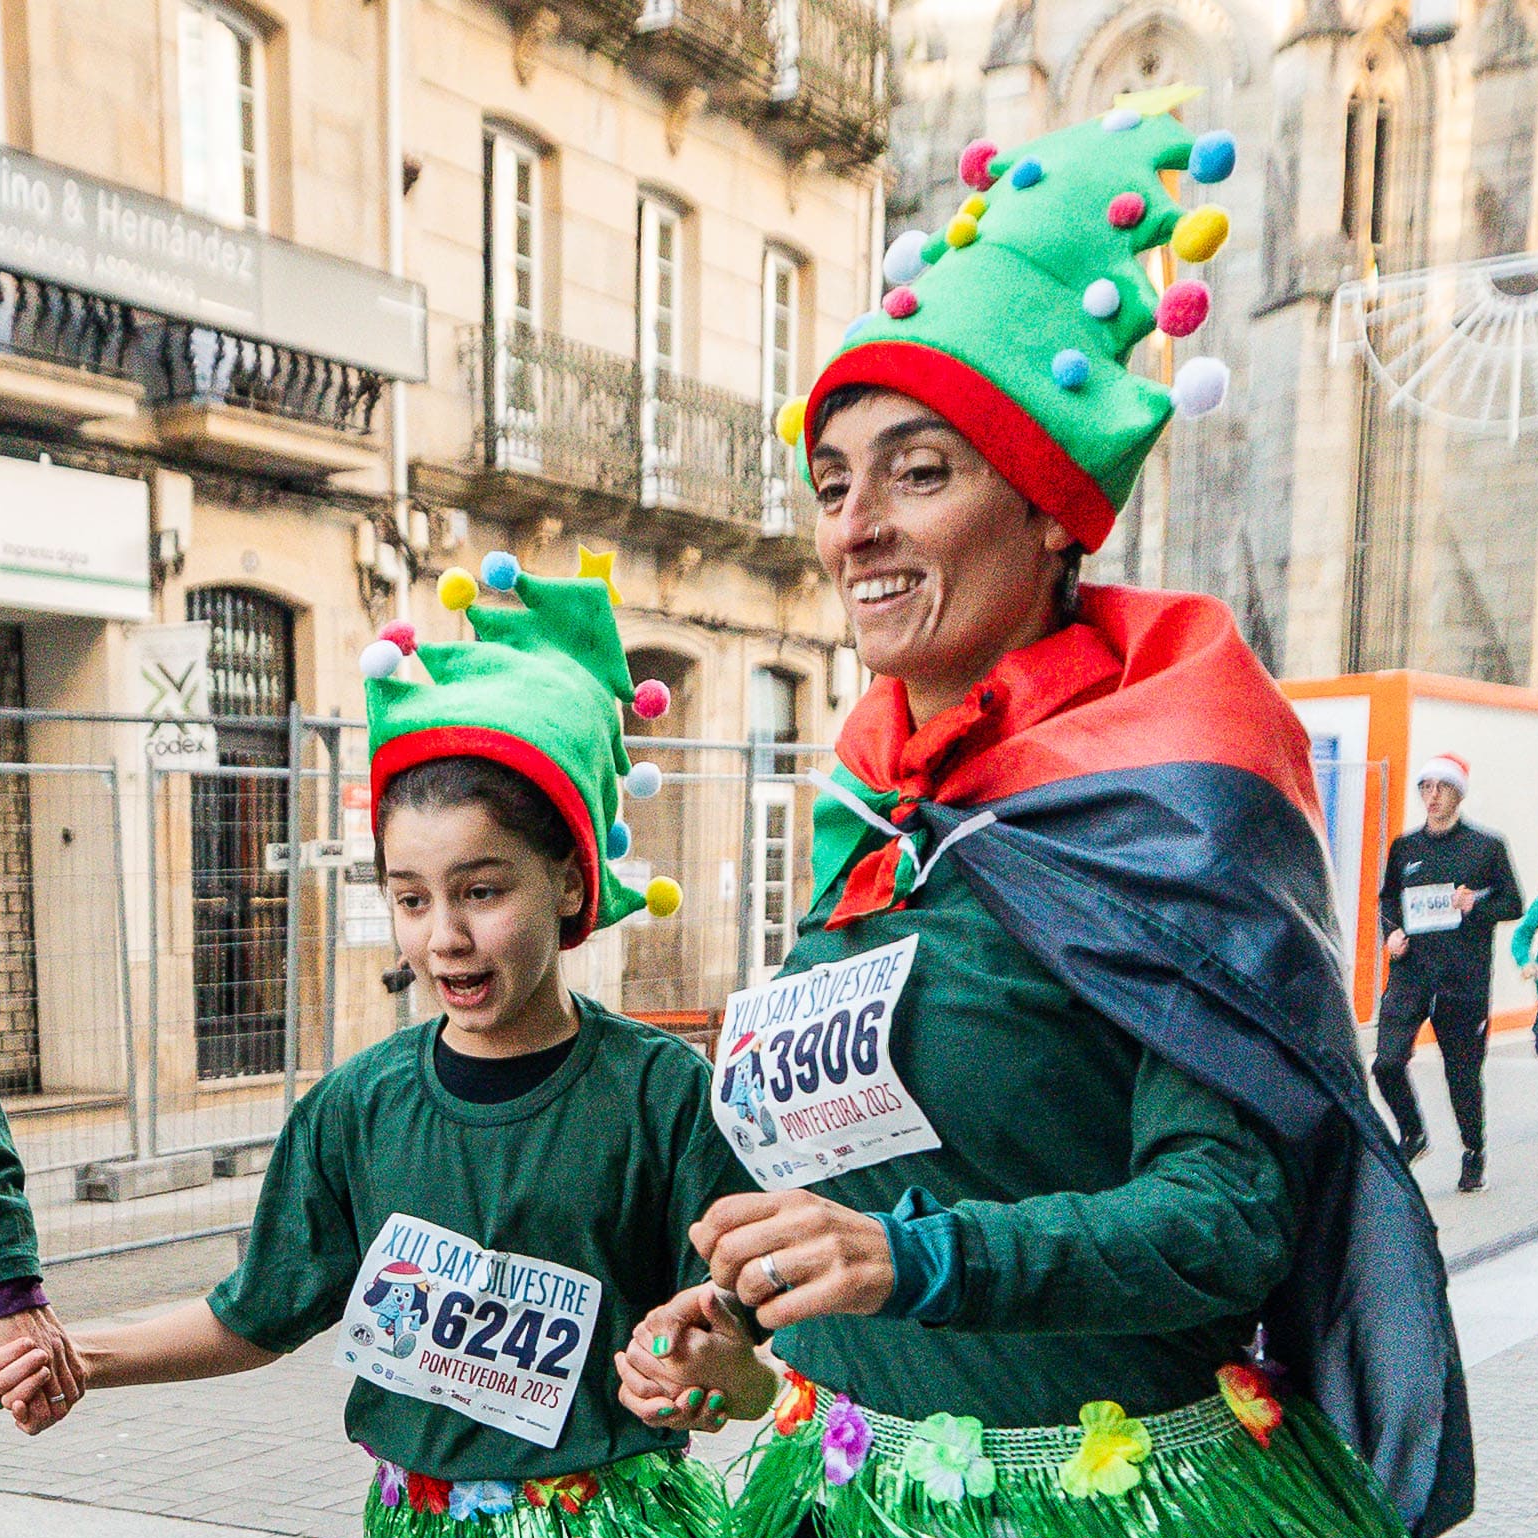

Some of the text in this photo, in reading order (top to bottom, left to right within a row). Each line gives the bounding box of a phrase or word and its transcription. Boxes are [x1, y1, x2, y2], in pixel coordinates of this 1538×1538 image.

[63, 178, 88, 225] &
[97, 189, 255, 281] Hernández
[145, 735, 207, 757] codex
[727, 951, 904, 1042] XLII SAN SILVESTRE
[769, 1000, 886, 1103] 3906
[780, 1082, 903, 1142] PONTEVEDRA 2025
[381, 1223, 591, 1316] XLII SAN SILVESTRE
[418, 1349, 563, 1409] PONTEVEDRA 2025
[431, 1290, 581, 1380] 6242
